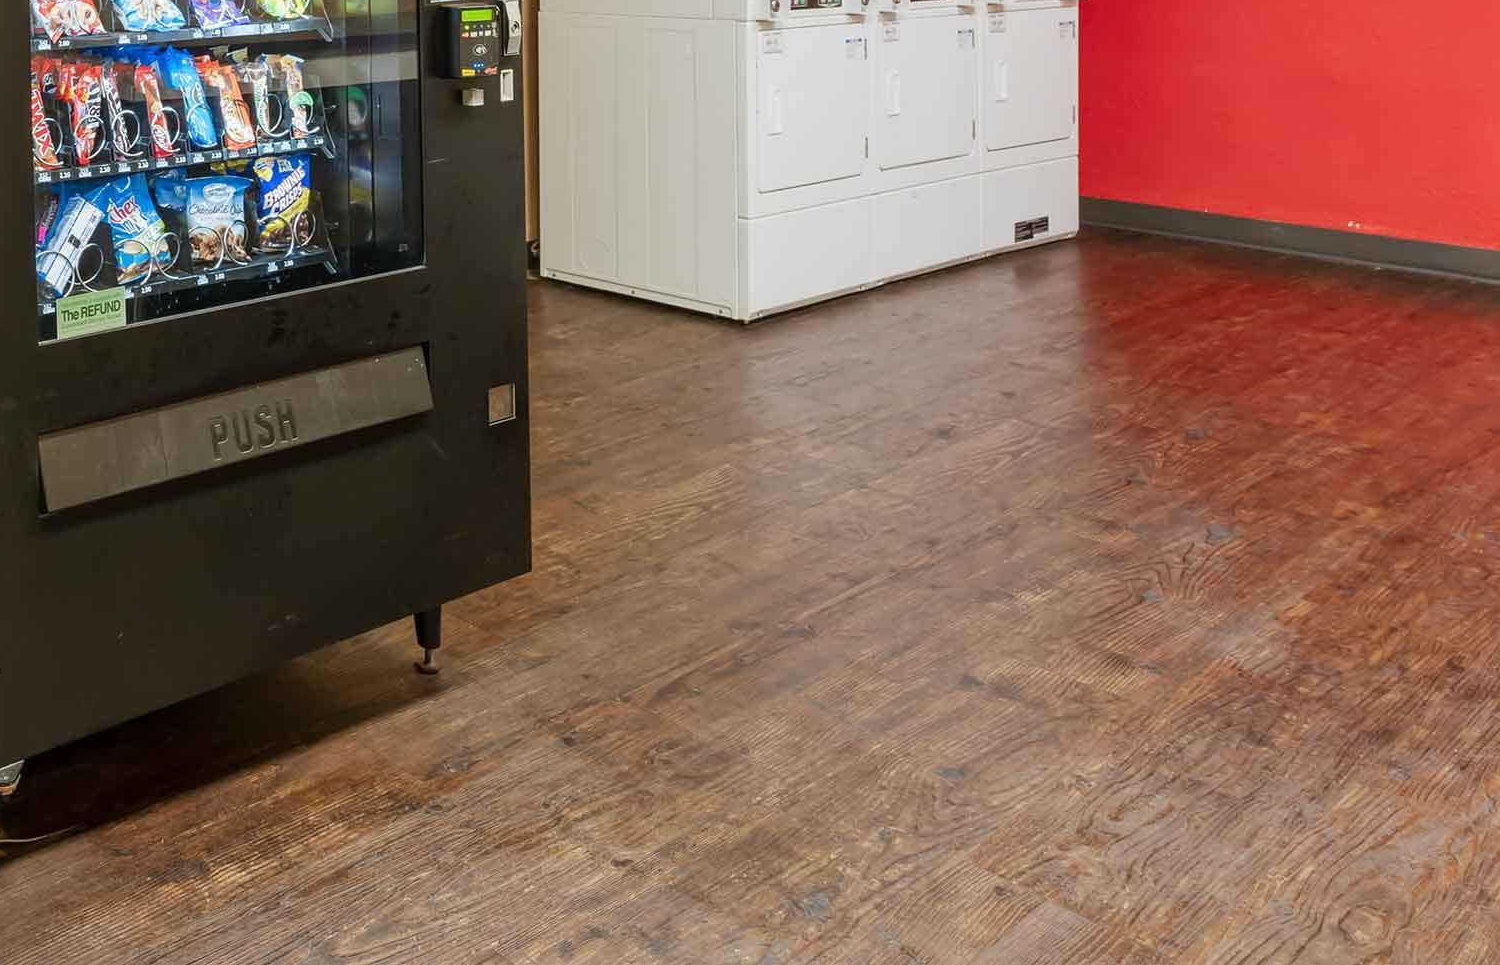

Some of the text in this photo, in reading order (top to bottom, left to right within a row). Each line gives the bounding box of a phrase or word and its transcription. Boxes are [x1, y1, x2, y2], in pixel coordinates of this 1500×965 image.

[264, 167, 306, 210] BROWNIE
[109, 196, 139, 223] Chex
[61, 307, 79, 322] The
[81, 299, 121, 319] REFUND
[210, 398, 301, 463] PUSH
